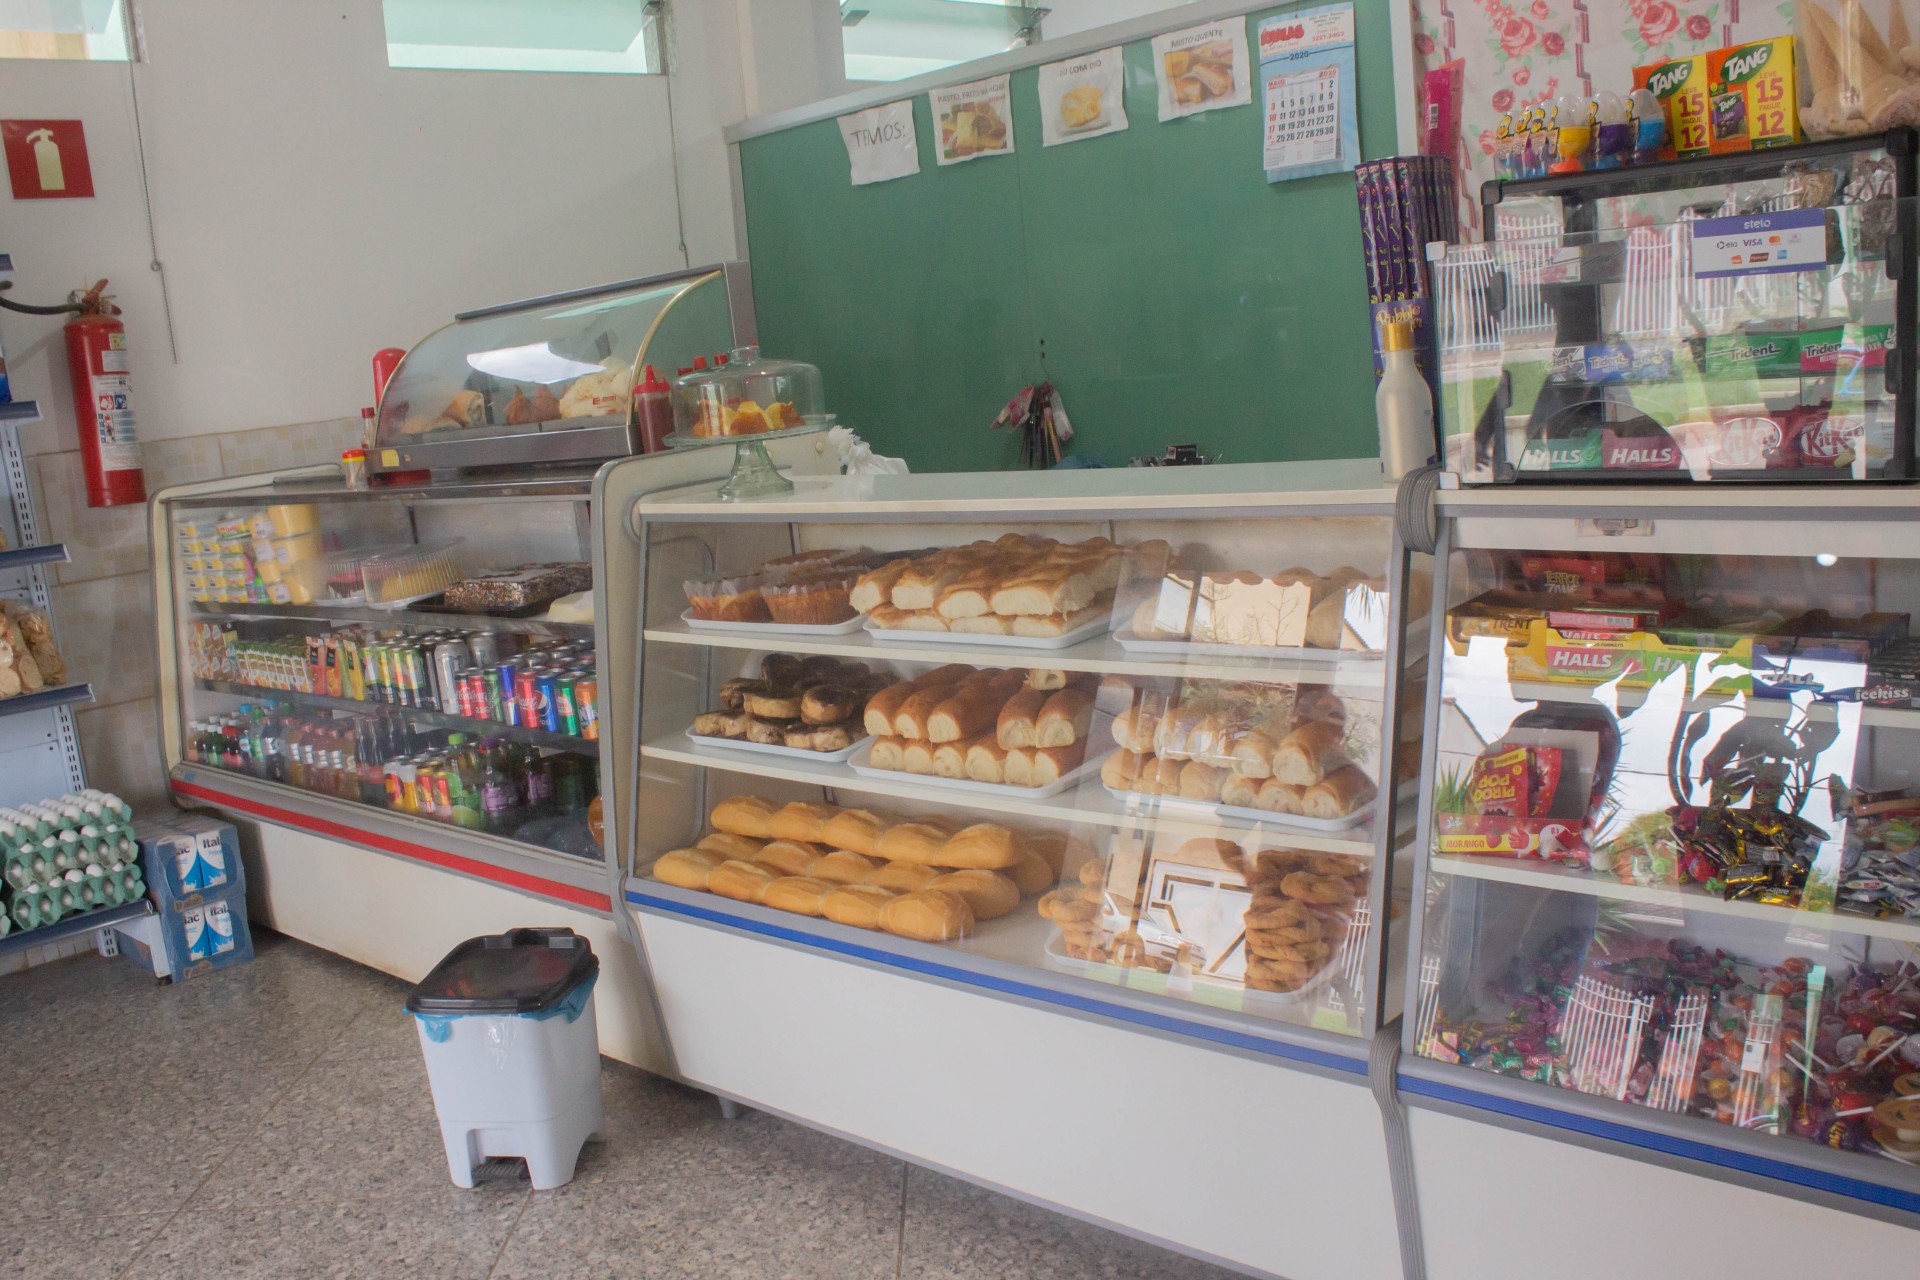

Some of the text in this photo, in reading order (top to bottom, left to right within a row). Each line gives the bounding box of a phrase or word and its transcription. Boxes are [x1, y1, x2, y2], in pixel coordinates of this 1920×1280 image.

[1171, 29, 1224, 49] MISTO QUENTE
[1290, 51, 1309, 61] 2020
[1724, 46, 1769, 81] TANG
[1069, 64, 1088, 74] COM
[1760, 71, 1777, 79] LEVE
[1267, 69, 1337, 88] MAIO 2020
[1329, 80, 1334, 88] 2
[1648, 64, 1688, 96] TANG
[938, 94, 961, 104] PASTEL
[962, 90, 980, 100] FRITO
[1682, 86, 1698, 95] LEVE
[1756, 77, 1784, 103] 15
[1271, 92, 1334, 110] 3 4 5 6 7 8 9
[1678, 93, 1705, 118] 15
[1719, 96, 1736, 112] TANG
[1759, 102, 1781, 111] PAGUE
[1270, 103, 1334, 122] 10 11 12 13 14 15 16
[1682, 116, 1702, 125] PAGUE
[1268, 115, 1334, 133] 17 18 19 20 21 22 23
[1756, 110, 1785, 136] 12
[851, 121, 906, 148] TEMOS:
[1276, 135, 1286, 143] 25
[1286, 134, 1294, 142] 26
[1296, 132, 1304, 140] 27
[1306, 130, 1314, 138] 28
[1316, 128, 1324, 136] 29
[1324, 126, 1334, 134] 30
[1681, 124, 1707, 149] 12
[1744, 219, 1771, 230] stelo
[1743, 238, 1763, 246] VISA
[1730, 342, 1778, 361] Trident
[1804, 343, 1841, 358] Triden
[1588, 352, 1628, 369] Trident
[1523, 449, 1581, 464] HALLS
[1610, 448, 1672, 464] HALLS
[1552, 650, 1612, 668] HALLS
[1855, 687, 1912, 701] icekiss
[1478, 774, 1510, 788] POP
[1446, 839, 1485, 849] MORANGO
